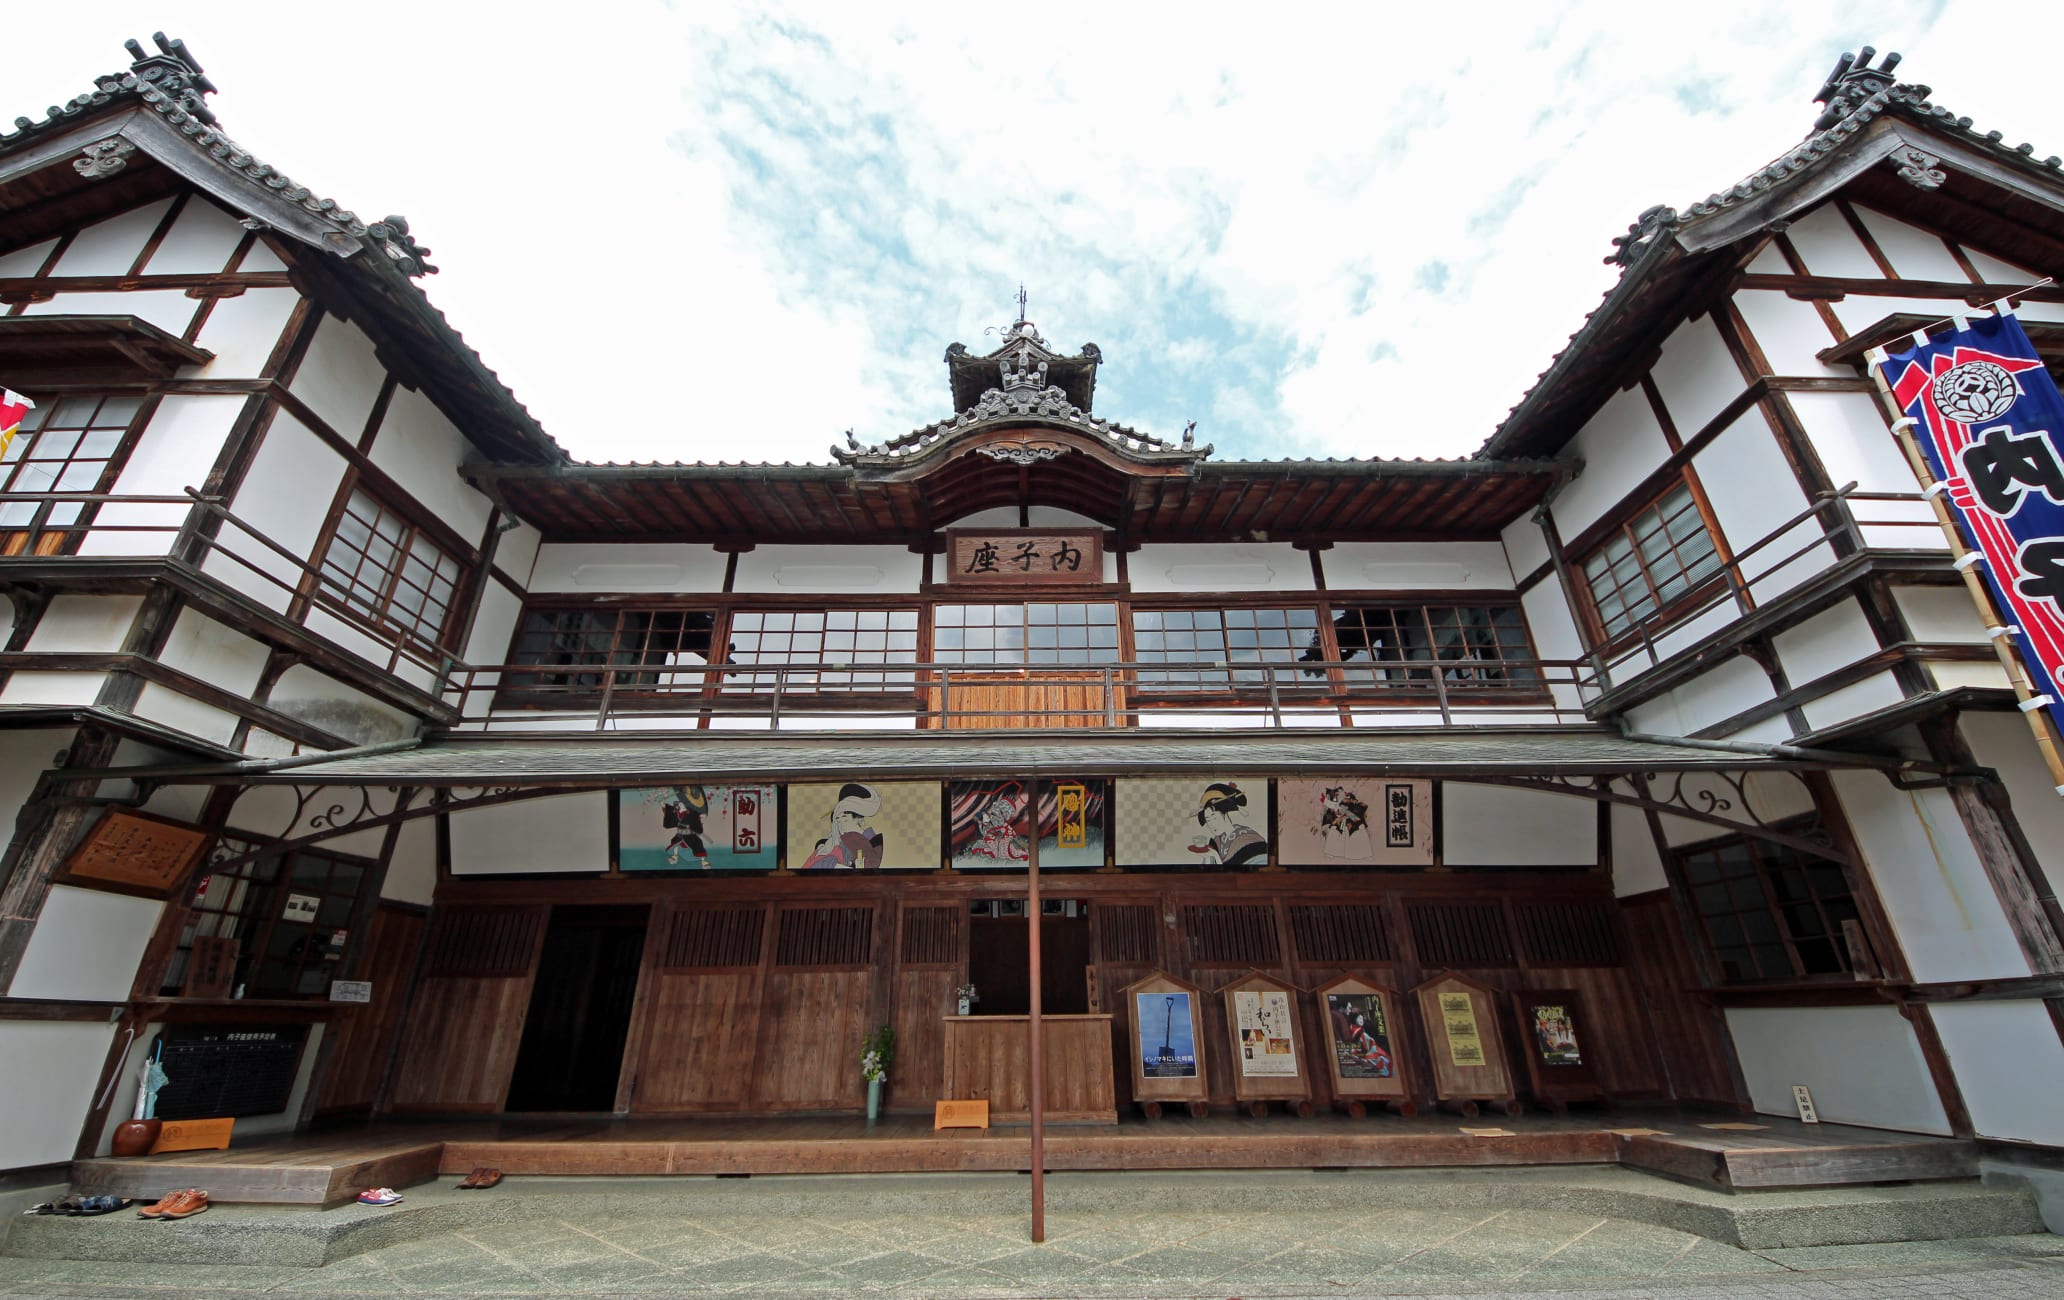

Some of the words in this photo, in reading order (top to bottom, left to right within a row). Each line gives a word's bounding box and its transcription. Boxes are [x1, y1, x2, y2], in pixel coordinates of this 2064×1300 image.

[965, 541, 1082, 573] 内子座
[738, 795, 756, 847] 助六
[1391, 791, 1409, 841] 勧進帳
